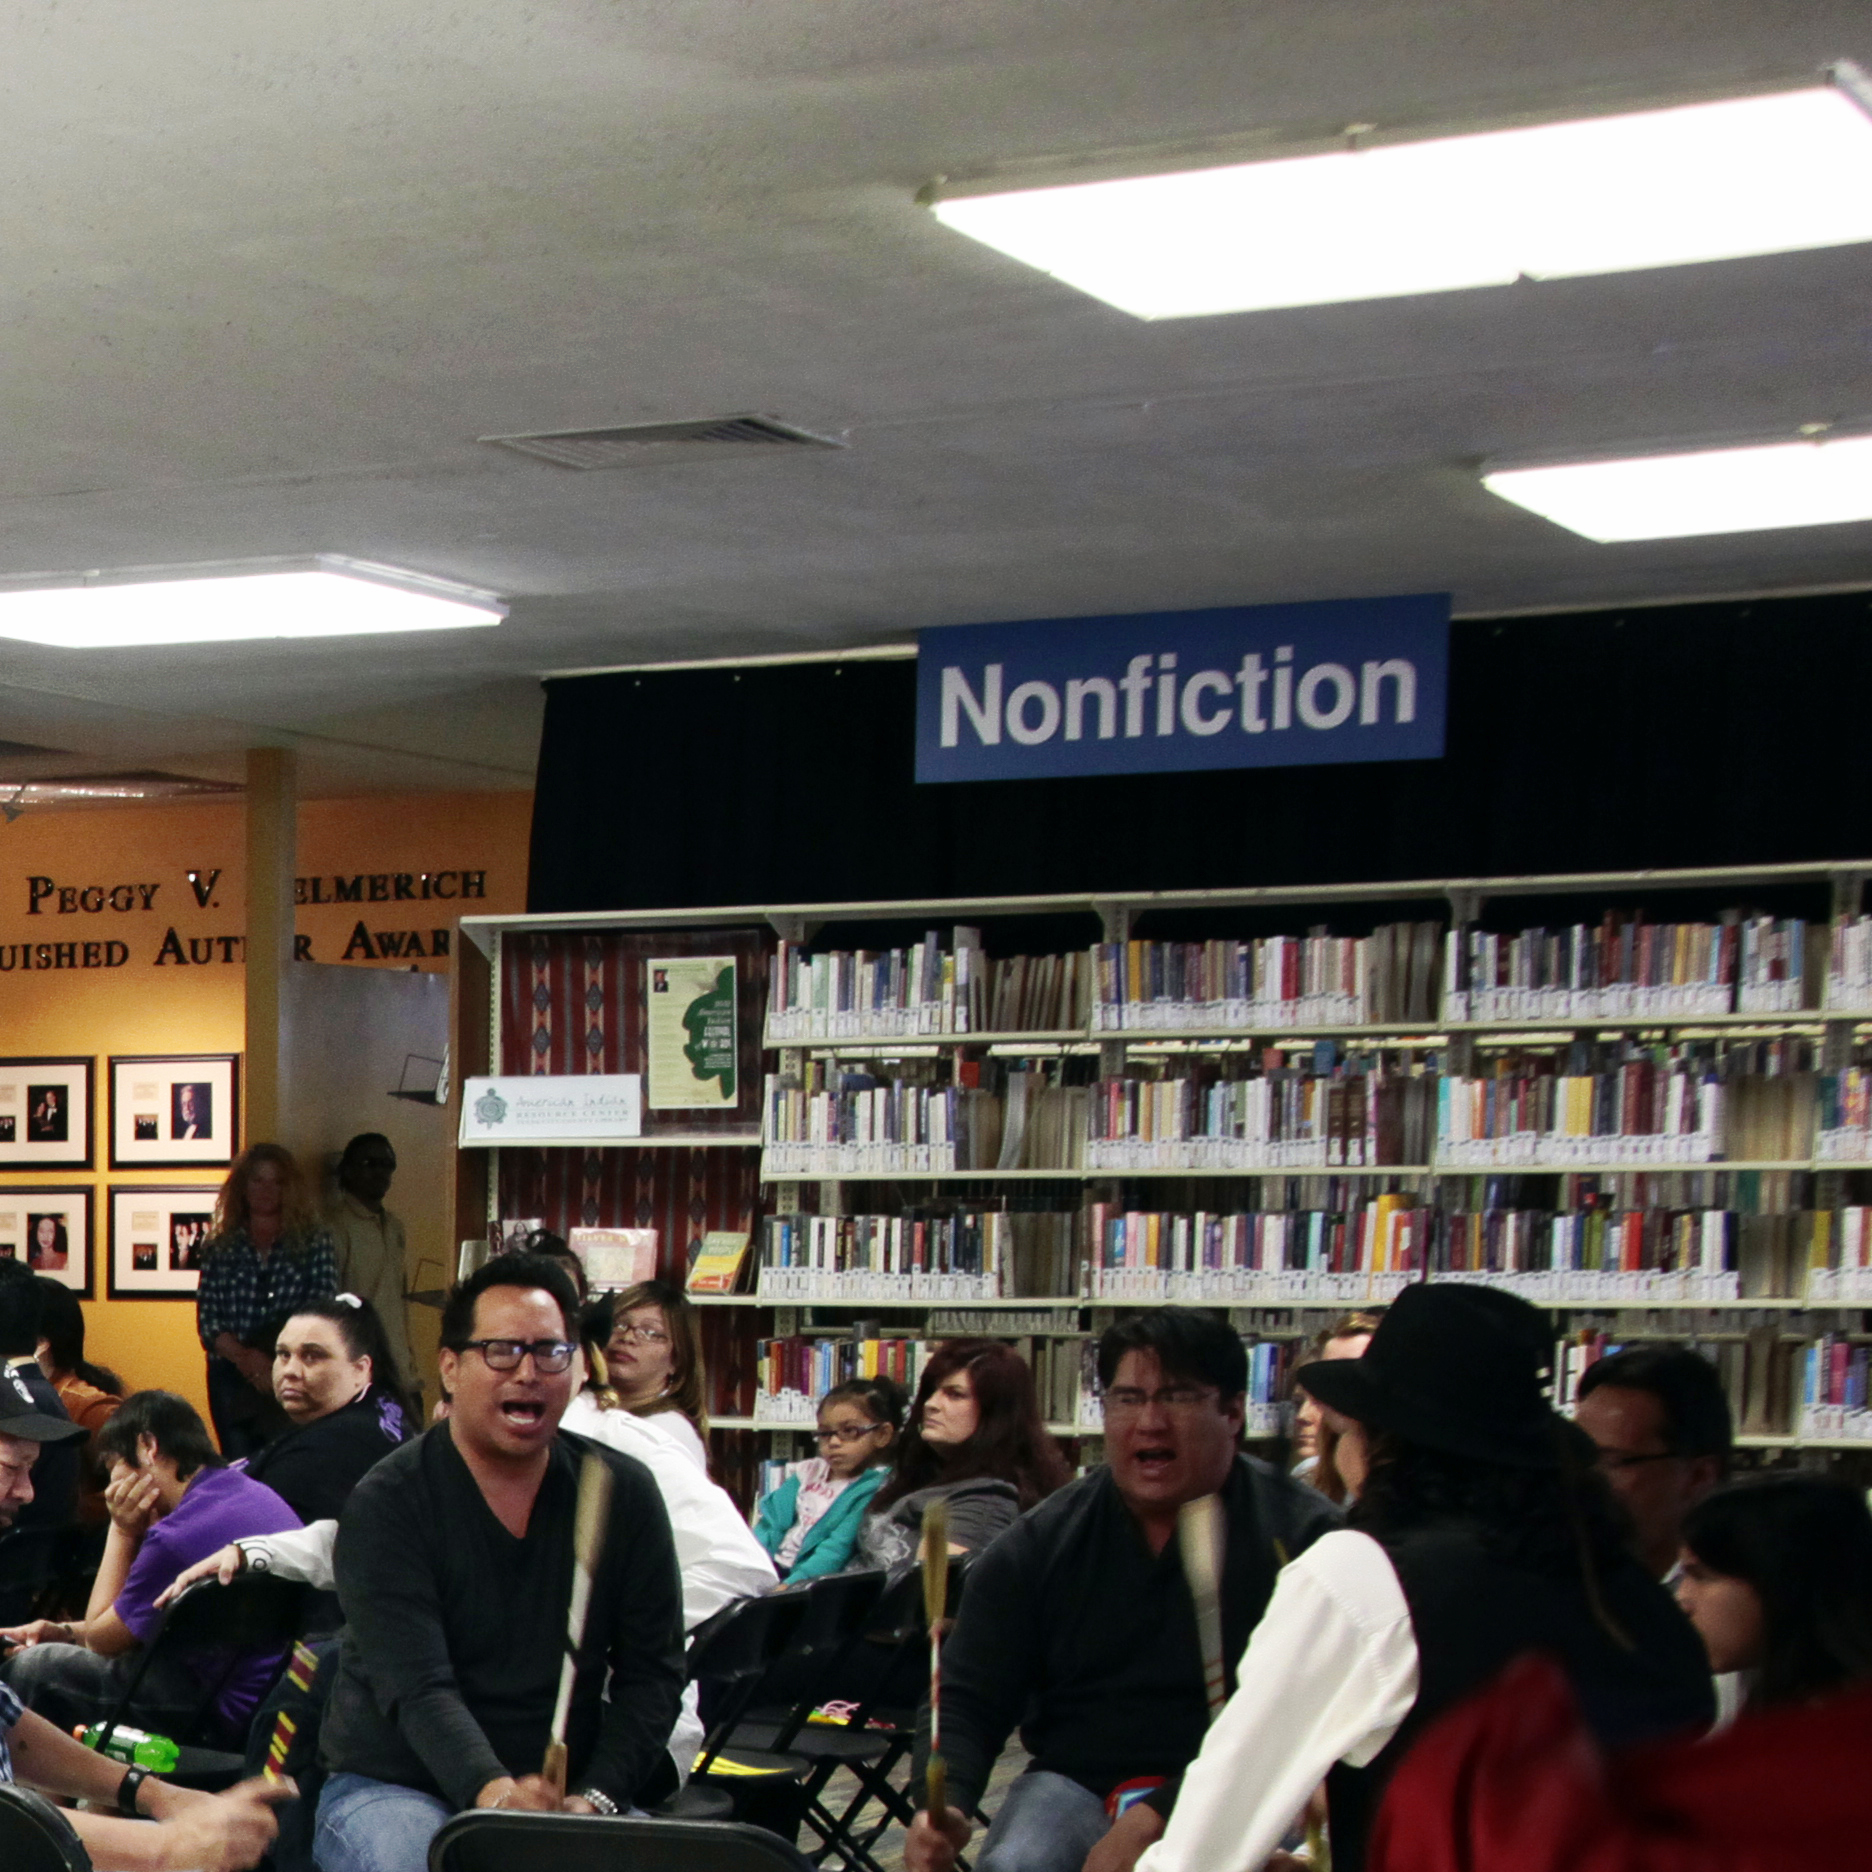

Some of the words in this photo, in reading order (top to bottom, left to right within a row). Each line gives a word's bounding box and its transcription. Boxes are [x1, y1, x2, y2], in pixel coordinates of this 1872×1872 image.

[940, 645, 1417, 747] Nonfiction
[186, 868, 222, 908] V.
[294, 870, 487, 905] ELMERICH
[341, 920, 450, 960] AWAR
[516, 1096, 575, 1107] American
[583, 1093, 626, 1106] Indian
